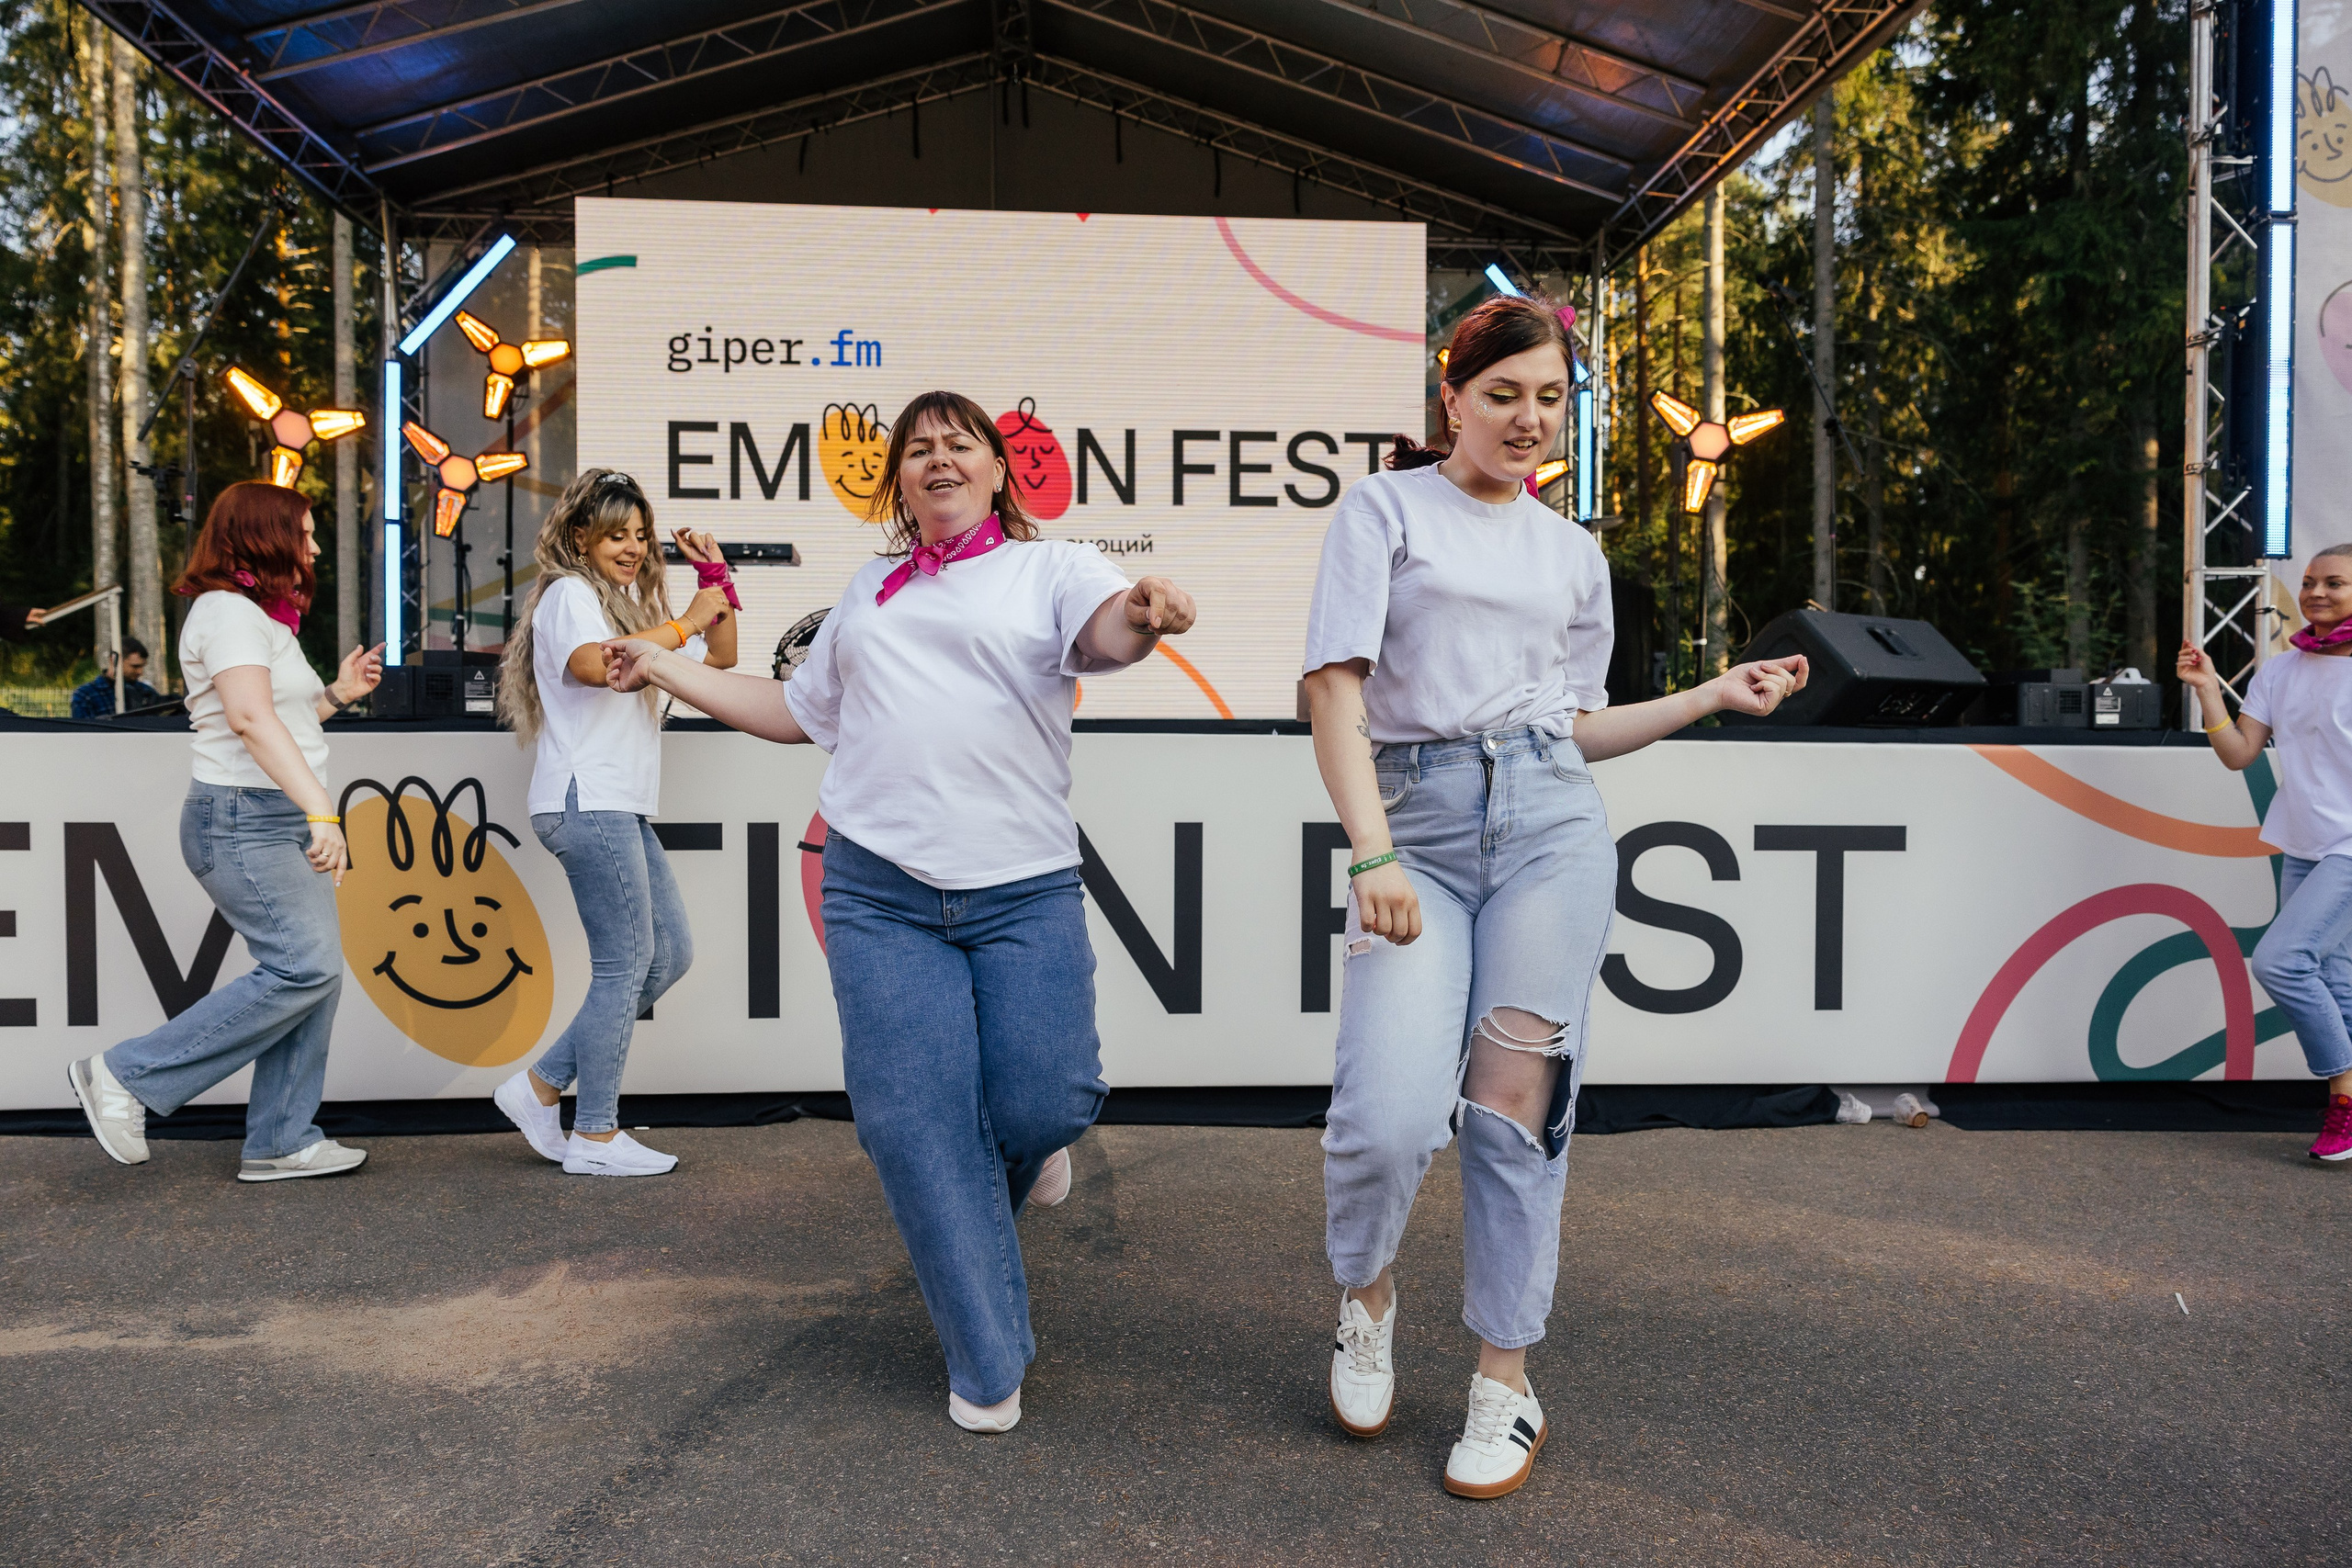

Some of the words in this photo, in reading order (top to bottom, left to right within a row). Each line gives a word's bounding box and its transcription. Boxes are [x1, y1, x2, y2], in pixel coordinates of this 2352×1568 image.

[668, 326, 881, 373] giper.fm
[1172, 430, 1396, 508] FEST
[1067, 534, 1153, 556] оций
[1301, 820, 1907, 1015] FST
